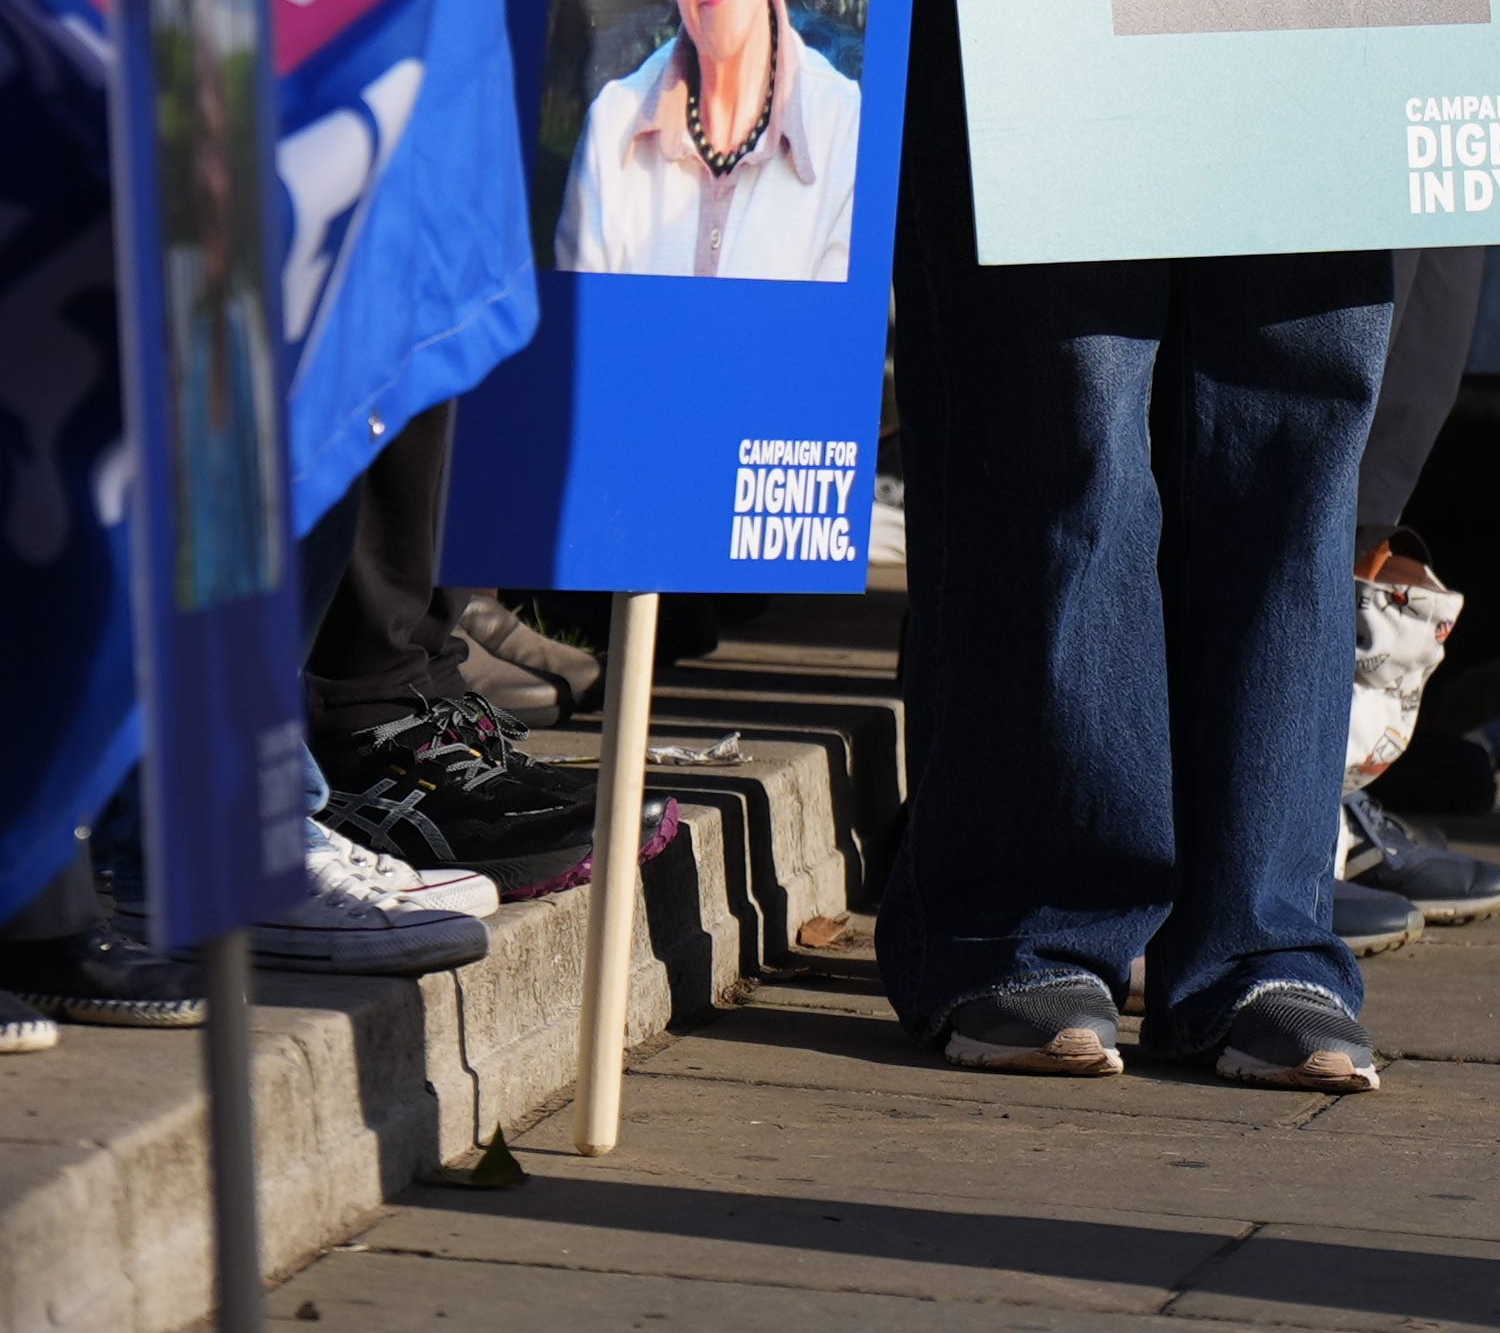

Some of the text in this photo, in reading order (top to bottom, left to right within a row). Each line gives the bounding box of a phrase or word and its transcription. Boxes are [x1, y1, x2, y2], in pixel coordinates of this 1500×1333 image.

[1408, 170, 1455, 214] IN
[738, 438, 859, 468] CAMPAIGN FOR
[733, 467, 857, 515] DIGNITY
[729, 515, 858, 562] IN DYING.
